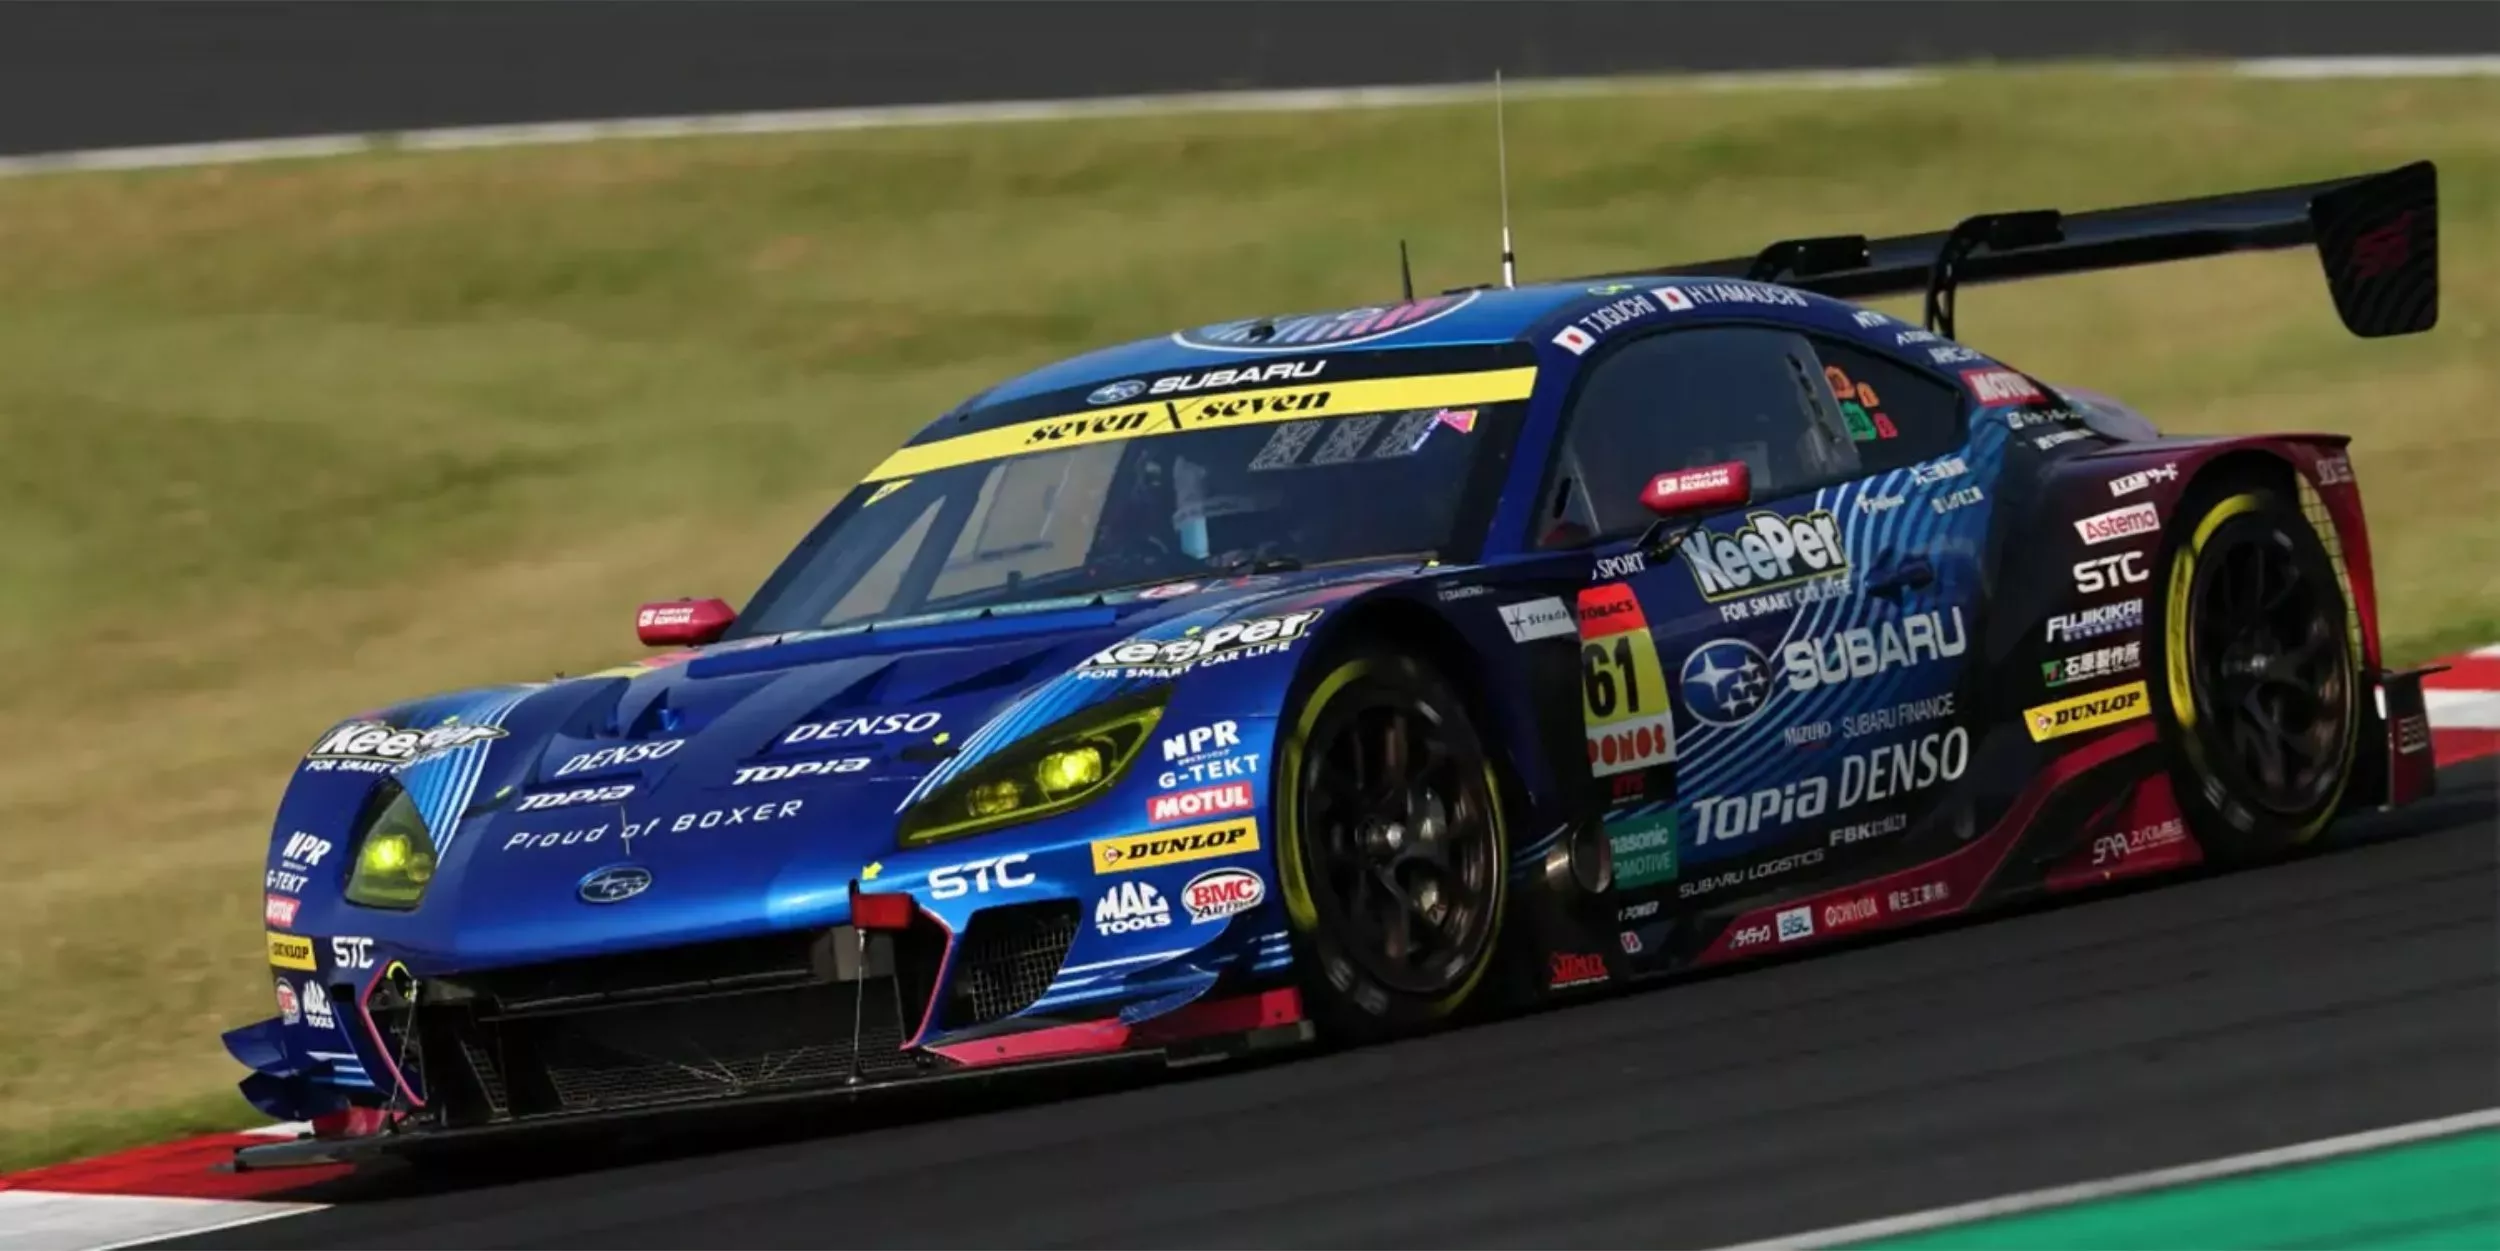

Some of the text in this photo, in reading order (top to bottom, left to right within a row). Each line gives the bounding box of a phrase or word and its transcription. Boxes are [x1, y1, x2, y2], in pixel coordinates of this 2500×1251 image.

[1149, 360, 1327, 394] SUBARU
[1025, 411, 1149, 444] seven
[1196, 391, 1331, 420] seven
[2085, 510, 2157, 539] Astemo
[1598, 552, 1645, 577] SPORT
[1681, 514, 1846, 594] KeePer
[2073, 550, 2150, 593] STC
[1527, 609, 1567, 626] Strada
[1578, 600, 1634, 620] TOBACS
[1720, 602, 1748, 623] FOR
[1753, 591, 1793, 616] SMART
[1076, 609, 1320, 669] KeePer
[1783, 606, 1966, 691] SUBARU
[1077, 641, 1291, 681] FOR SMART CAR LIFE
[1582, 636, 1639, 718] 61
[1842, 692, 1955, 739] SUBARU FINANCE
[2055, 691, 2140, 726] DUNLOP
[784, 712, 942, 744] DENSO
[1162, 720, 1240, 761] NPR
[1587, 724, 1666, 766] PONOS
[305, 759, 338, 773] FOR
[338, 758, 391, 774] SMART
[554, 738, 686, 777] DENSO
[1158, 754, 1260, 788] G-TEKT
[1837, 726, 1970, 809] DENSO
[1154, 785, 1249, 820] MOTUL
[503, 800, 803, 850] Proud of BOXER
[1609, 824, 1669, 854] nasonic
[1829, 822, 1871, 847] FBK
[282, 831, 333, 866] NPR
[1127, 827, 1247, 860] DUNLOP
[266, 868, 309, 894] G-TEKT
[928, 853, 1036, 900] STC
[1679, 848, 1825, 898] SUBARU LOGISTICS
[1095, 881, 1170, 922] MAC
[1193, 878, 1254, 907] BMC
[1624, 901, 1660, 919] POWER
[1096, 912, 1173, 936] TOOLS
[332, 936, 374, 968] STC
